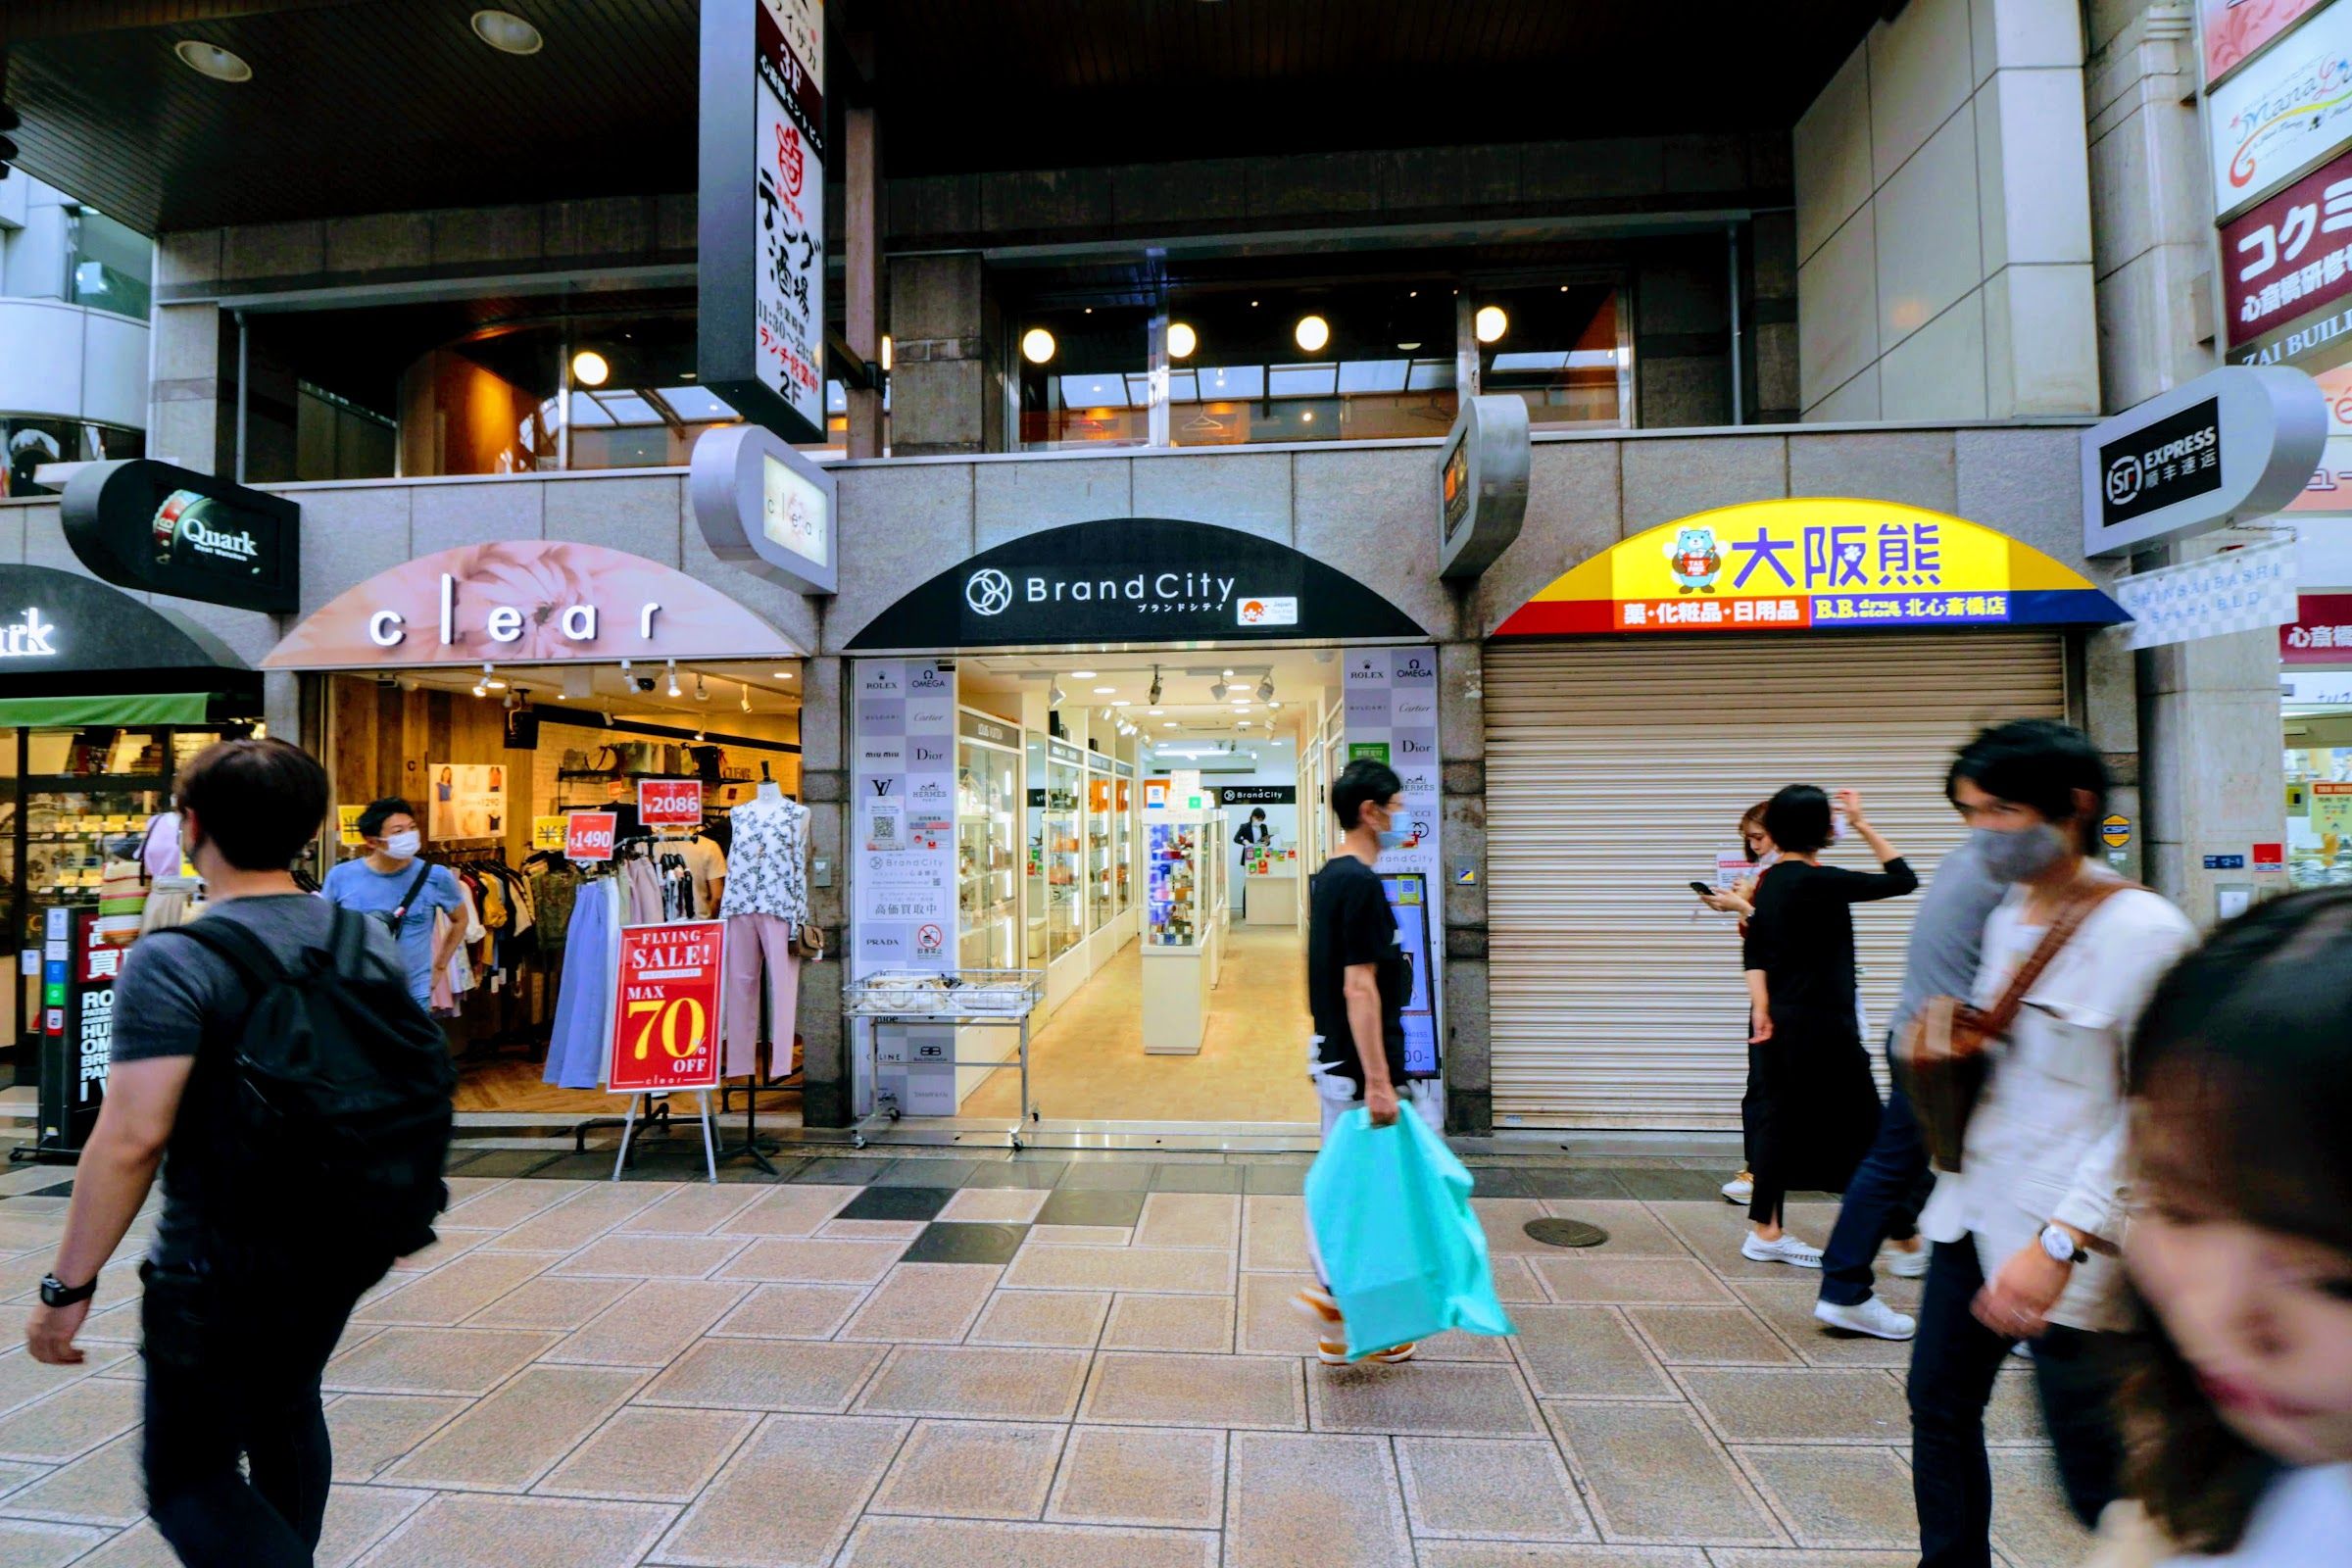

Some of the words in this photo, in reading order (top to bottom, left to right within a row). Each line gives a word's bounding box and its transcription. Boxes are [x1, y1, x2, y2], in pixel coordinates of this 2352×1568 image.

[780, 43, 803, 94] 3F
[759, 167, 821, 270] テング
[768, 234, 809, 323] 酒場
[776, 300, 806, 339] 営業時間
[760, 325, 819, 394] ランチ営業中
[779, 370, 803, 406] 2F
[2144, 426, 2217, 470] EXPRESS
[766, 492, 823, 541] clear
[182, 518, 259, 557] Quark
[1732, 523, 1941, 589] 大阪熊
[2131, 563, 2281, 608] SHINSAIBASHI
[369, 573, 662, 647] clear
[1138, 603, 1224, 612] ブランドシティ
[1624, 600, 1799, 624] 薬・化粧品・日用品
[1905, 596, 2006, 616] 北心斎橋店
[1396, 669, 1433, 678] OMEGA
[913, 712, 944, 721] Cartier
[1398, 703, 1431, 712] Cartier
[917, 749, 944, 760] Dior
[1402, 740, 1432, 753] Dior
[1381, 855, 1434, 863] randCity
[875, 904, 937, 915] 高価買取中
[642, 930, 701, 945] FLYING
[632, 945, 710, 969] SALE!
[627, 985, 664, 1001] MAX
[673, 1058, 707, 1073] OFF
[645, 1074, 682, 1085] clear
